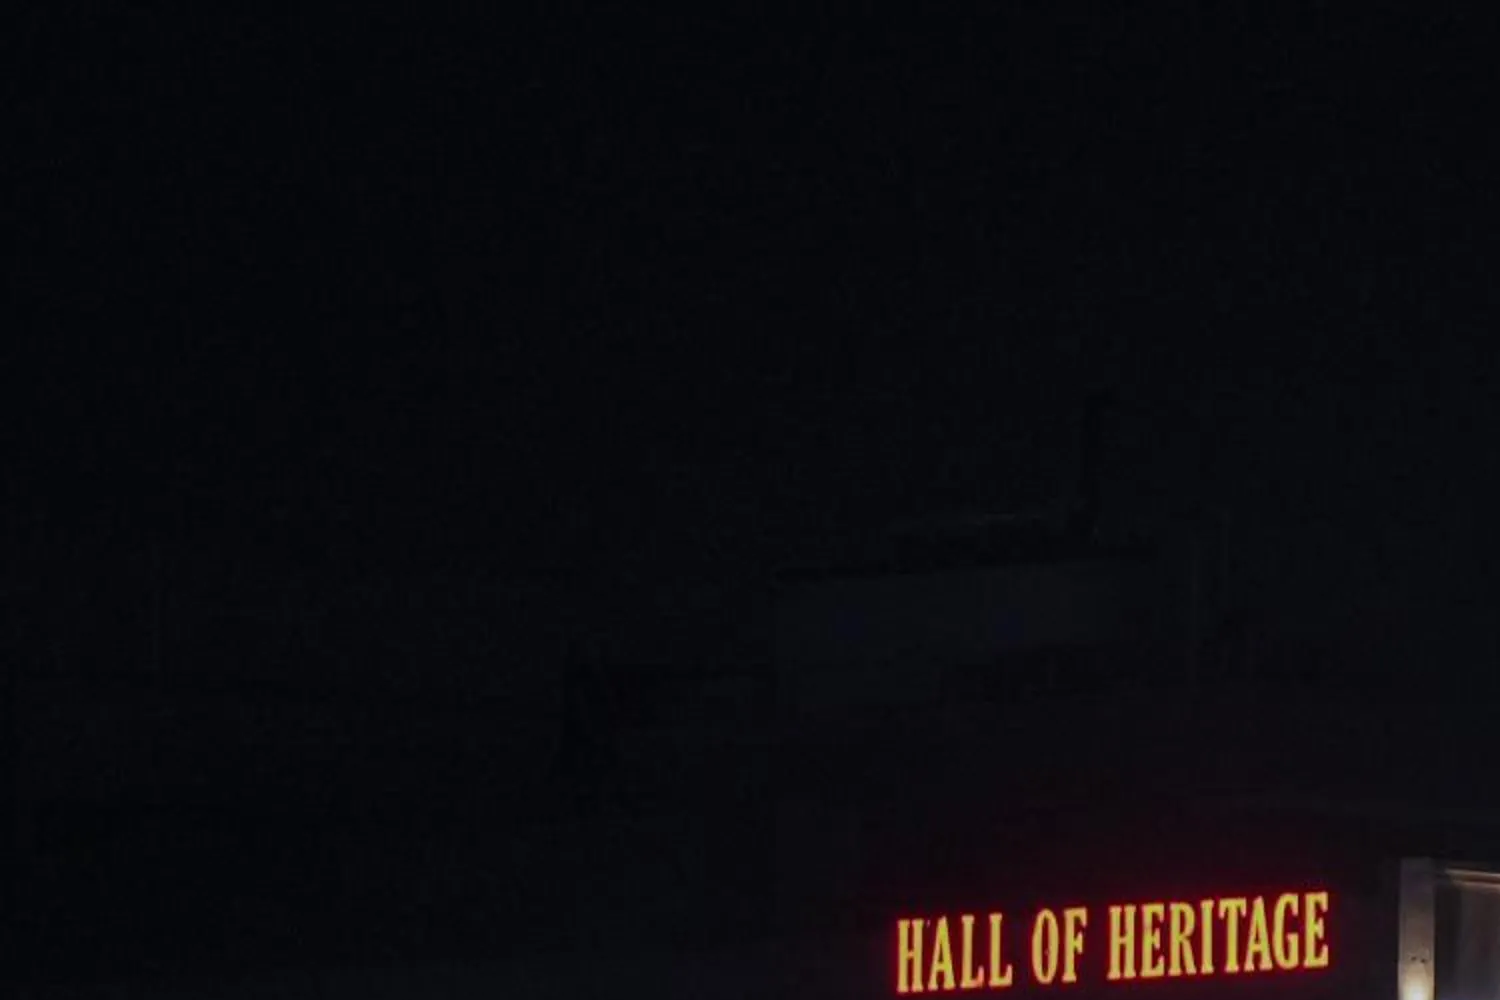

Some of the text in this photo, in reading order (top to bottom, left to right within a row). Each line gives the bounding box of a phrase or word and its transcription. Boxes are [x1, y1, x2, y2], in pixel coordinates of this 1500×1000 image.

[897, 891, 1329, 993] HALL OF HERITAGE
